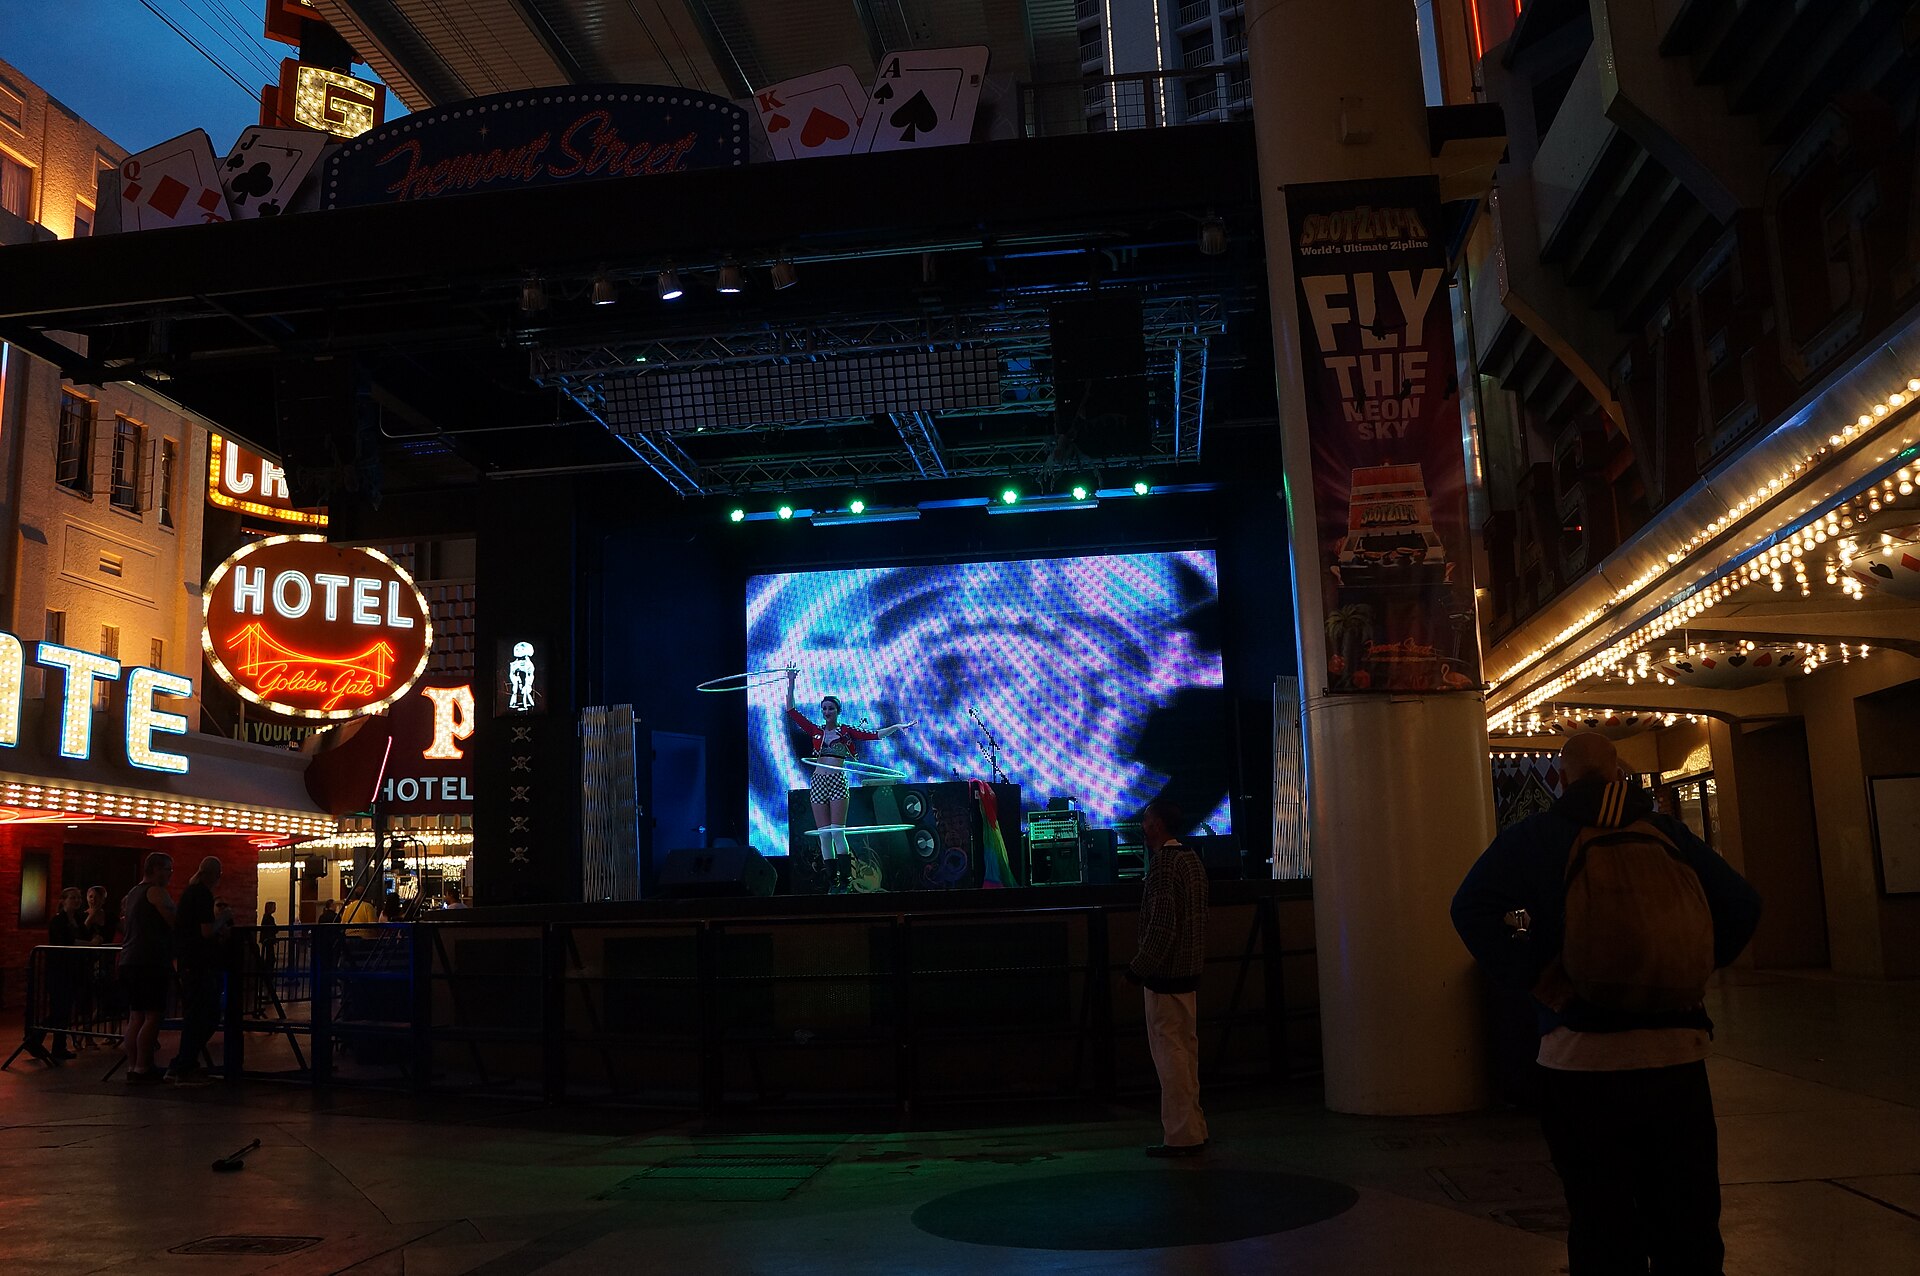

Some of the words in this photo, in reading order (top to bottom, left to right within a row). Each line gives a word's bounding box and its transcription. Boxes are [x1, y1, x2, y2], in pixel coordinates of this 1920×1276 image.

[881, 57, 901, 79] A
[294, 66, 375, 138] G
[756, 89, 785, 114] K
[240, 134, 260, 150] J
[375, 130, 551, 201] Fremont
[548, 108, 698, 178] Street
[123, 160, 142, 181] Q
[1300, 246, 1341, 256] World's
[1343, 242, 1389, 253] Ultimate
[1390, 240, 1429, 251] Zipline
[1300, 267, 1445, 353] FLY
[1323, 351, 1429, 399] THE
[1341, 397, 1421, 422] NEON
[1357, 420, 1410, 441] SKY
[233, 565, 415, 629] HOTEL
[257, 663, 328, 698] Golden
[323, 670, 374, 710] Gate
[0, 630, 193, 775] TE
[254, 722, 293, 742] YOUR
[421, 685, 475, 759] P
[383, 777, 474, 801] HOTEL
